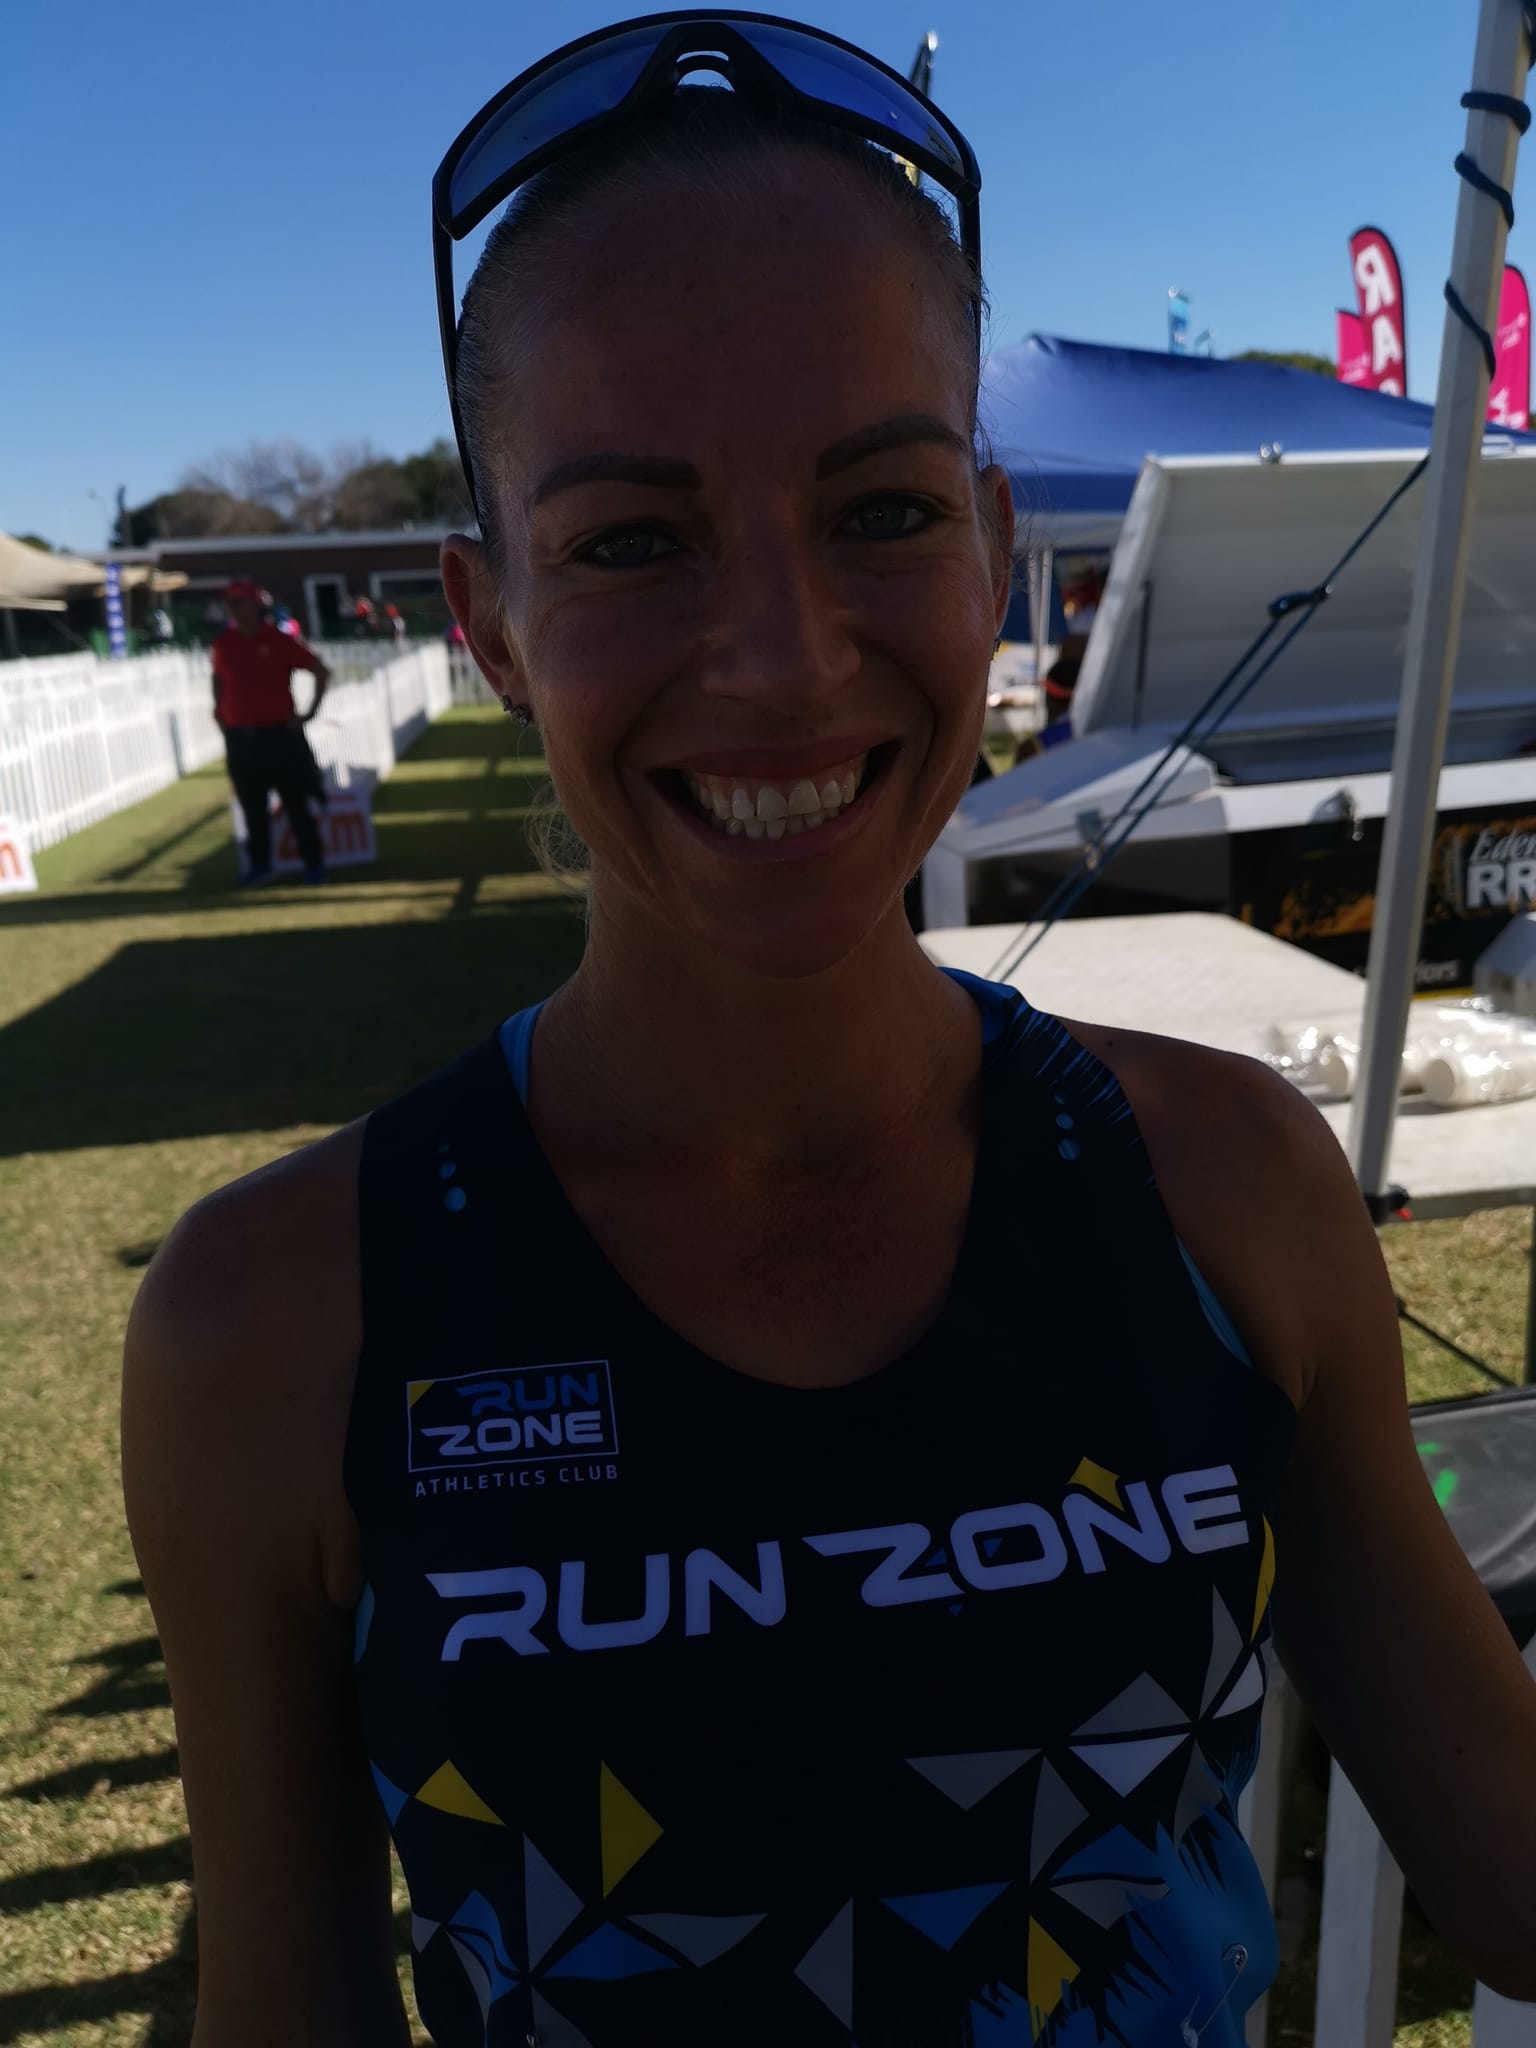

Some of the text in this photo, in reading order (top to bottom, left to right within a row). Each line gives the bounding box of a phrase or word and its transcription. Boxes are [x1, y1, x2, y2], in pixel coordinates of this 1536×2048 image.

[456, 1372, 600, 1416] RUN
[420, 1410, 605, 1457] ZONE
[415, 1464, 618, 1498] ATHLETICS CLUB
[425, 1464, 1250, 1662] RUN ZONE
